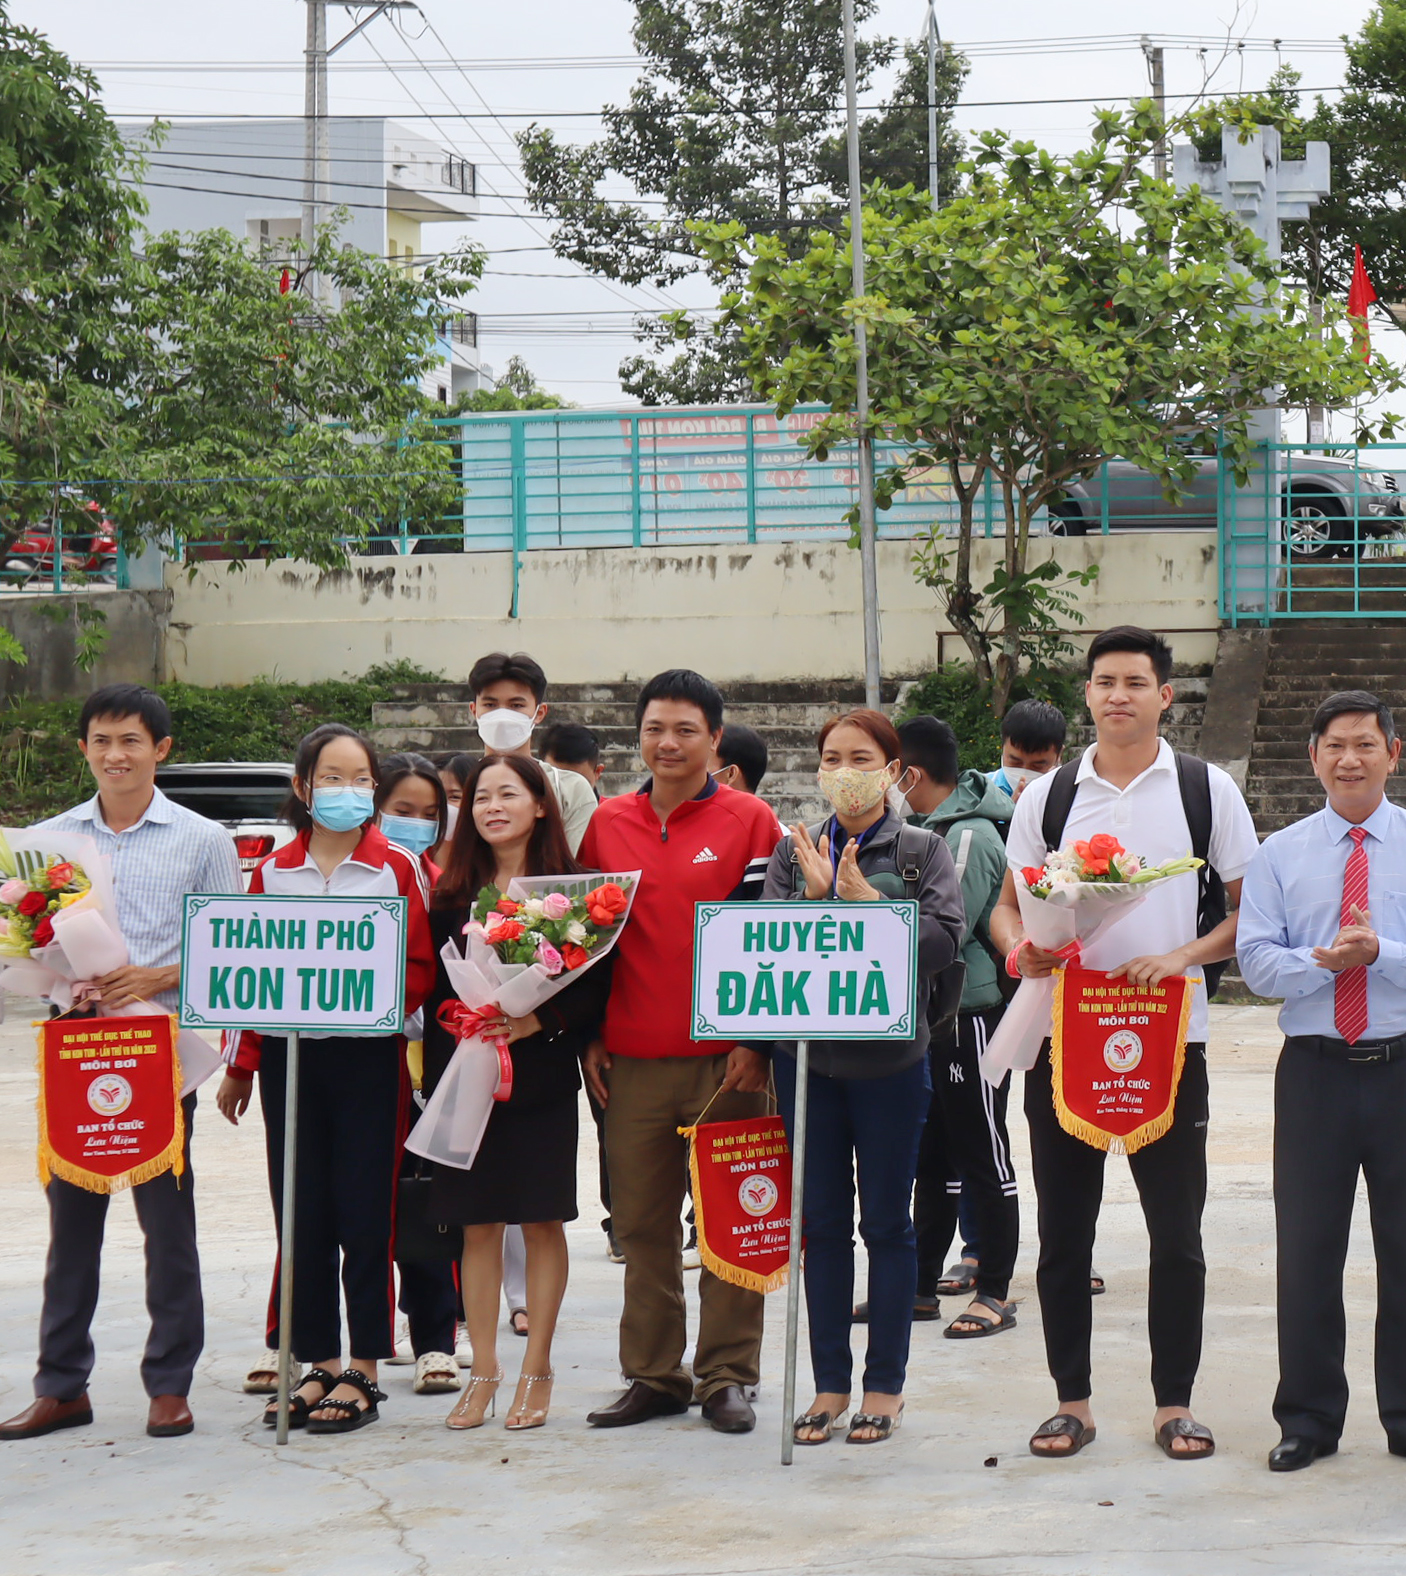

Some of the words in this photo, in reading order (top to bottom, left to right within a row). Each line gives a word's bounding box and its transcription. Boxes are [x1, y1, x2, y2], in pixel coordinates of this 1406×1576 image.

[693, 856, 718, 864] adidas
[210, 912, 306, 950] THÀNH
[317, 911, 379, 951] PHỐ
[744, 915, 864, 959] HUYỆN
[209, 966, 284, 1010] KON
[297, 968, 375, 1012] TUM
[717, 962, 812, 1016] ĐĂK
[828, 961, 890, 1016] HÀ
[1099, 1016, 1126, 1026] MÔN
[1129, 1016, 1149, 1025] BƠI
[81, 1060, 110, 1071] MÔN
[1093, 1081, 1111, 1090] BAN
[1113, 1076, 1125, 1088] TỔ
[1128, 1079, 1150, 1090] CHỨC
[77, 1124, 100, 1133] BAN
[101, 1118, 115, 1131] TỔ
[731, 1162, 756, 1173] MÔN
[732, 1225, 751, 1235] BAN
[753, 1219, 765, 1231] TỔ
